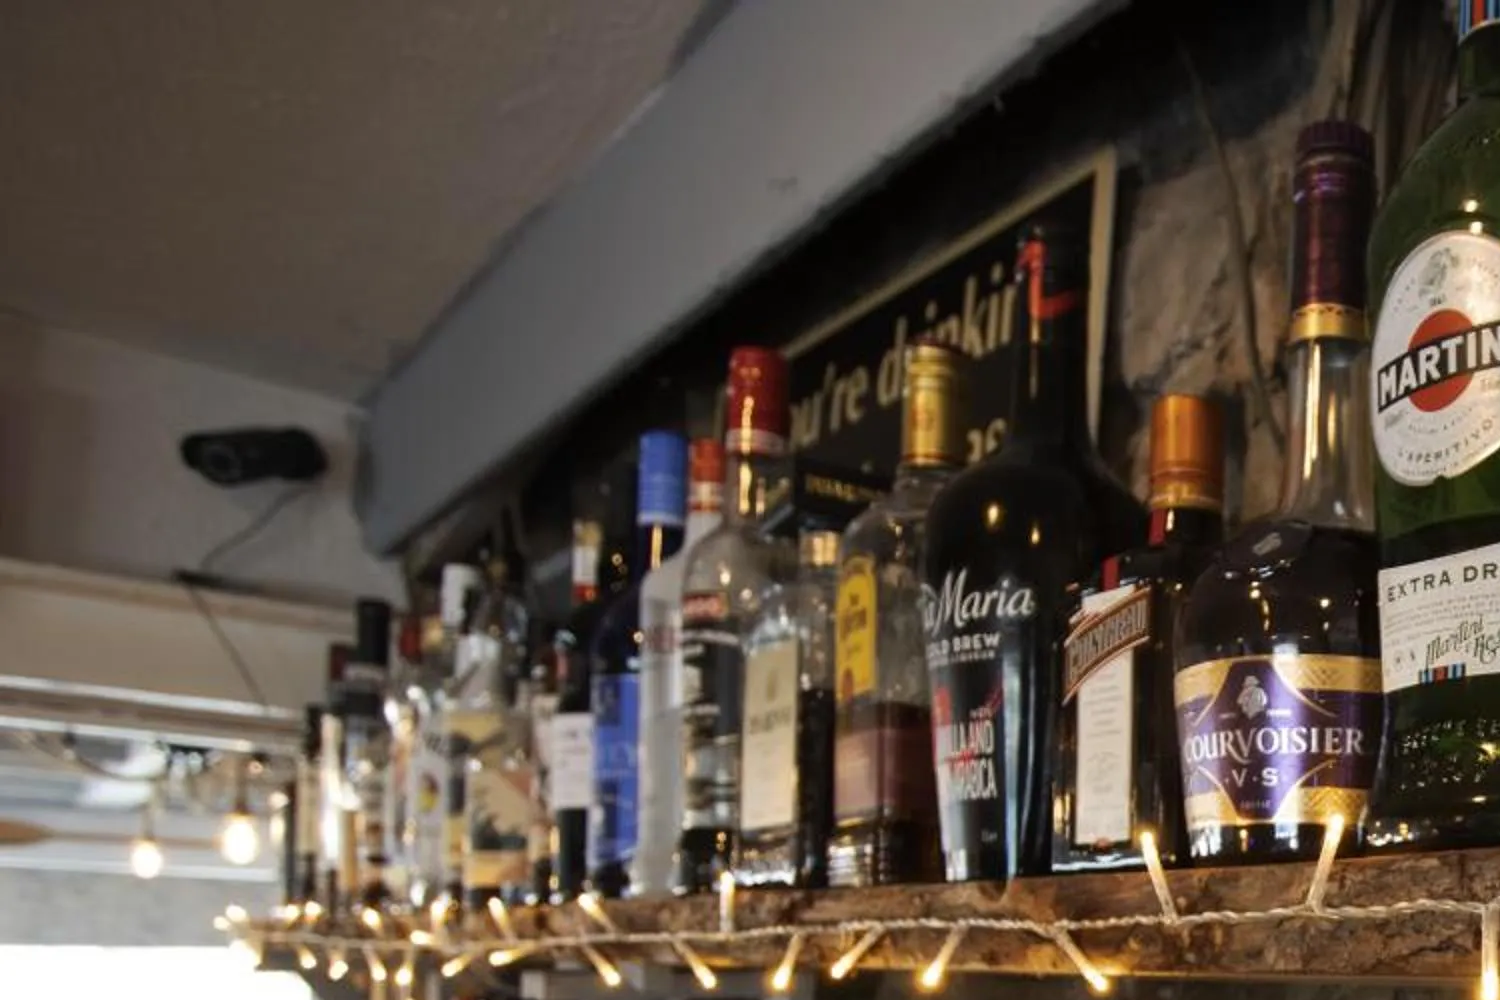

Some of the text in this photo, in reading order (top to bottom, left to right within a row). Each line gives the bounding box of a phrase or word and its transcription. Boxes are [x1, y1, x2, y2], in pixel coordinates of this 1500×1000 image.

[932, 566, 1036, 637] Maria
[1387, 569, 1452, 603] EXTRA
[951, 631, 1001, 653] BREW
[1184, 726, 1366, 764] COURVOISIER
